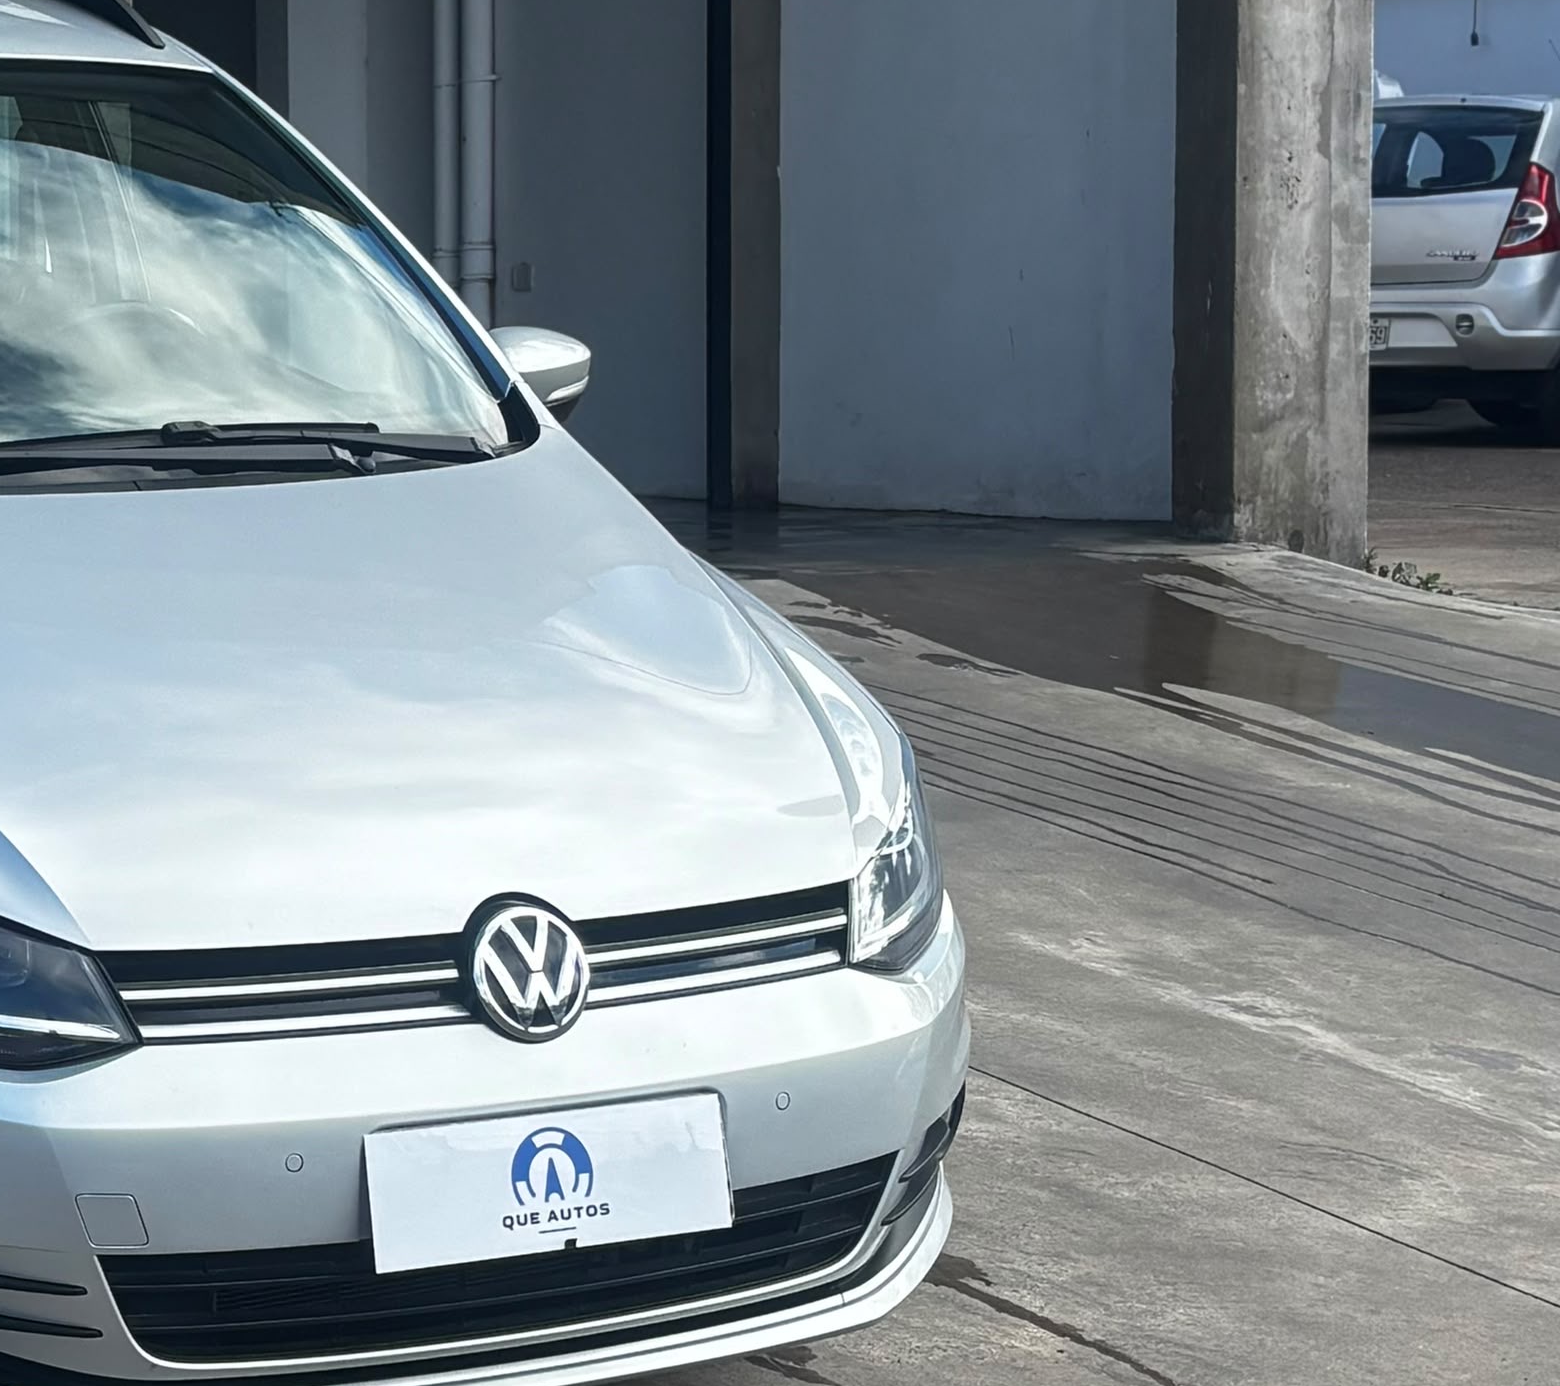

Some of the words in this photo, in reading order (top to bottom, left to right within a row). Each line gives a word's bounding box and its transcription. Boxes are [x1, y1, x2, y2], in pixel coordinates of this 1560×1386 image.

[475, 908, 587, 1032] VW
[502, 1211, 541, 1231] QUE
[547, 1202, 611, 1223] AUTOS
